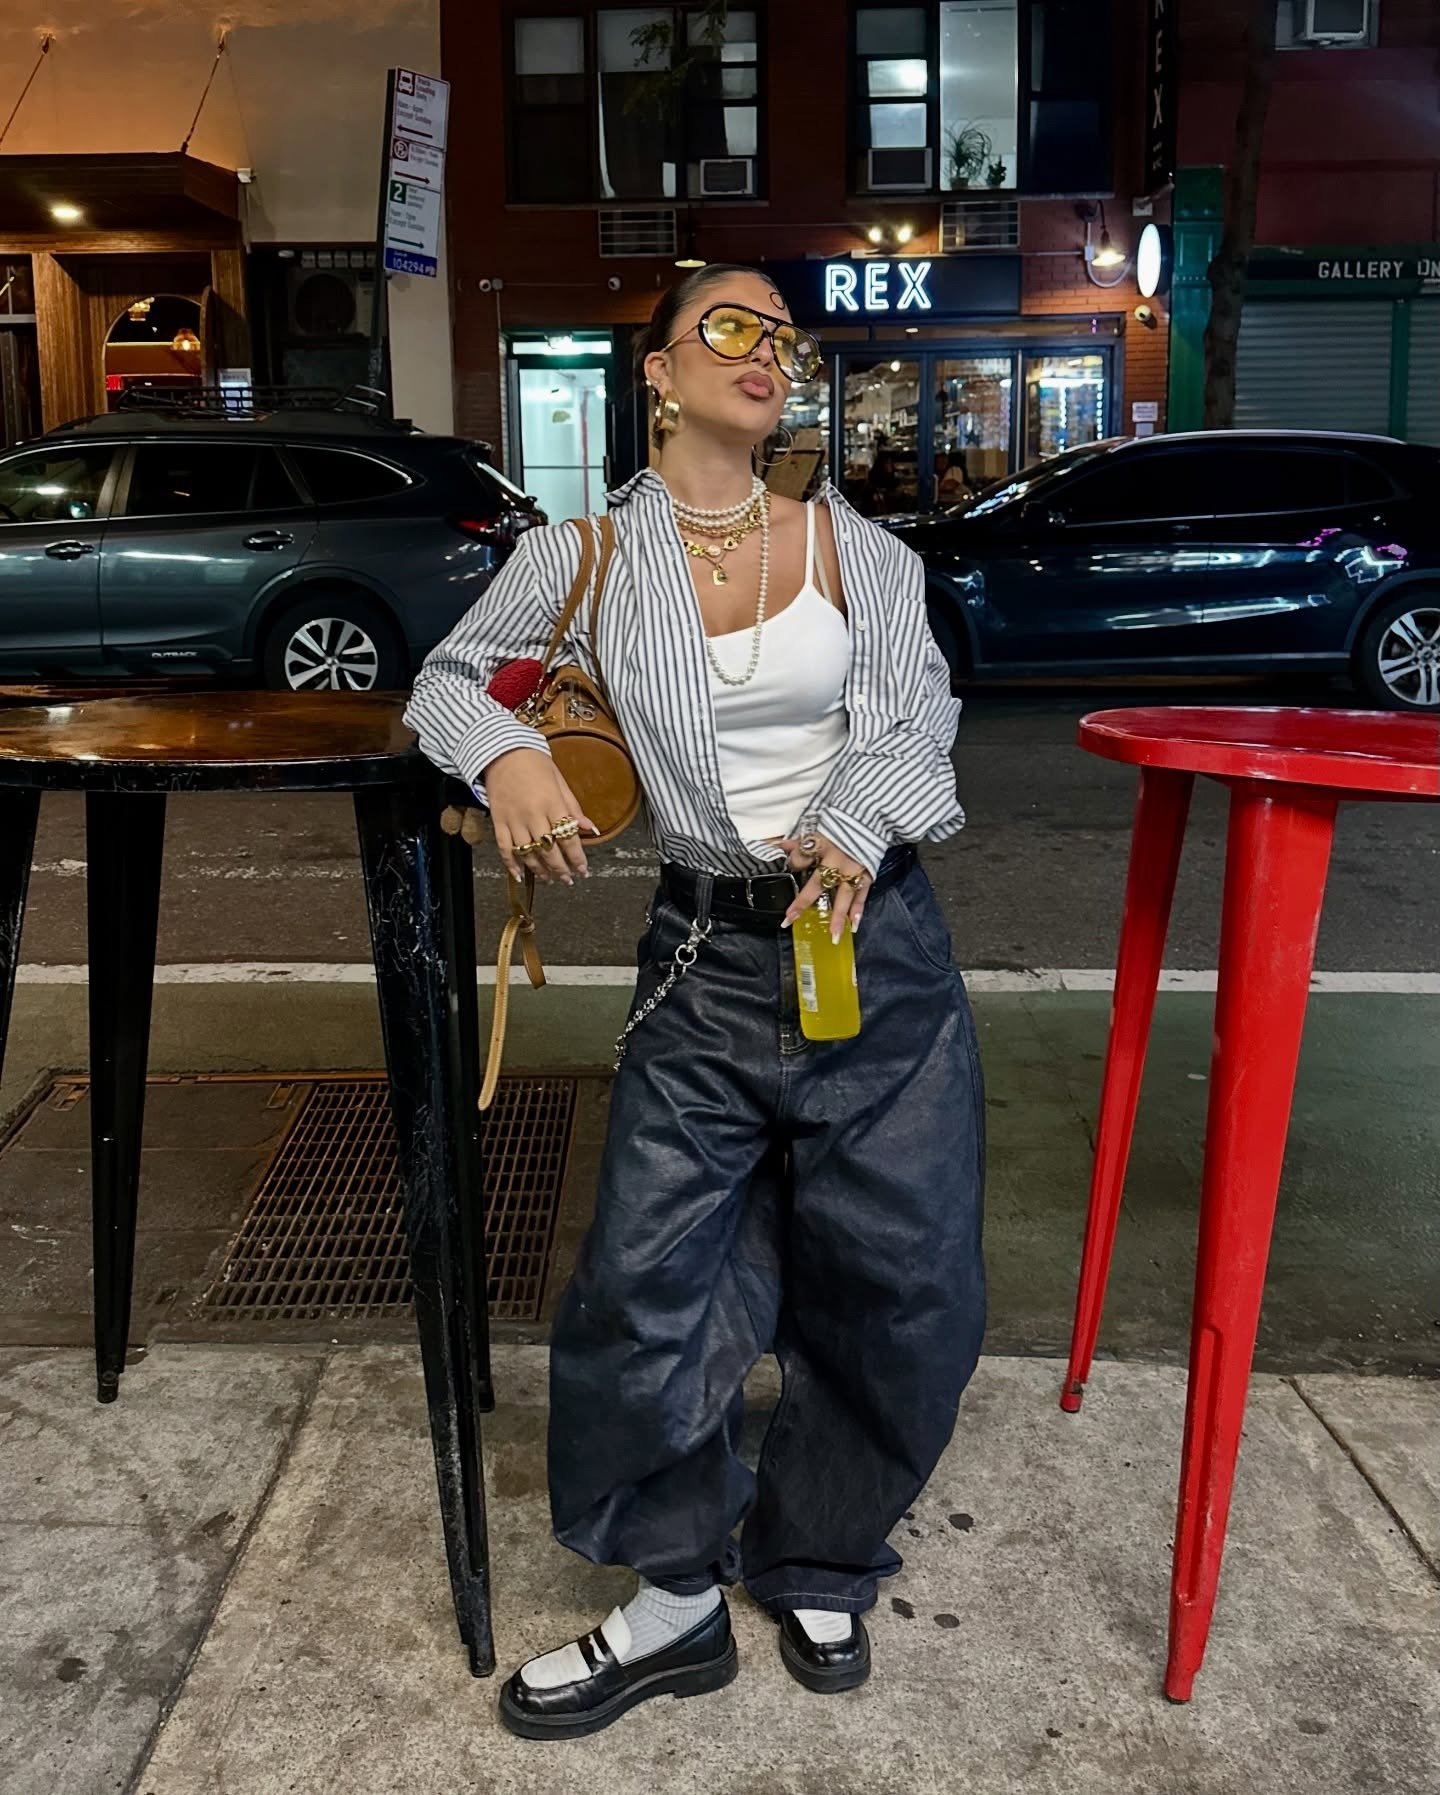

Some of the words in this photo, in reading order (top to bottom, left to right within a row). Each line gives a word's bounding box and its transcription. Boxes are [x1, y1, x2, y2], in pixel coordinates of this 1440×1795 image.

[393, 183, 403, 202] 2
[393, 257, 424, 274] 104294
[1318, 260, 1404, 279] GALLERY
[825, 262, 932, 312] REX
